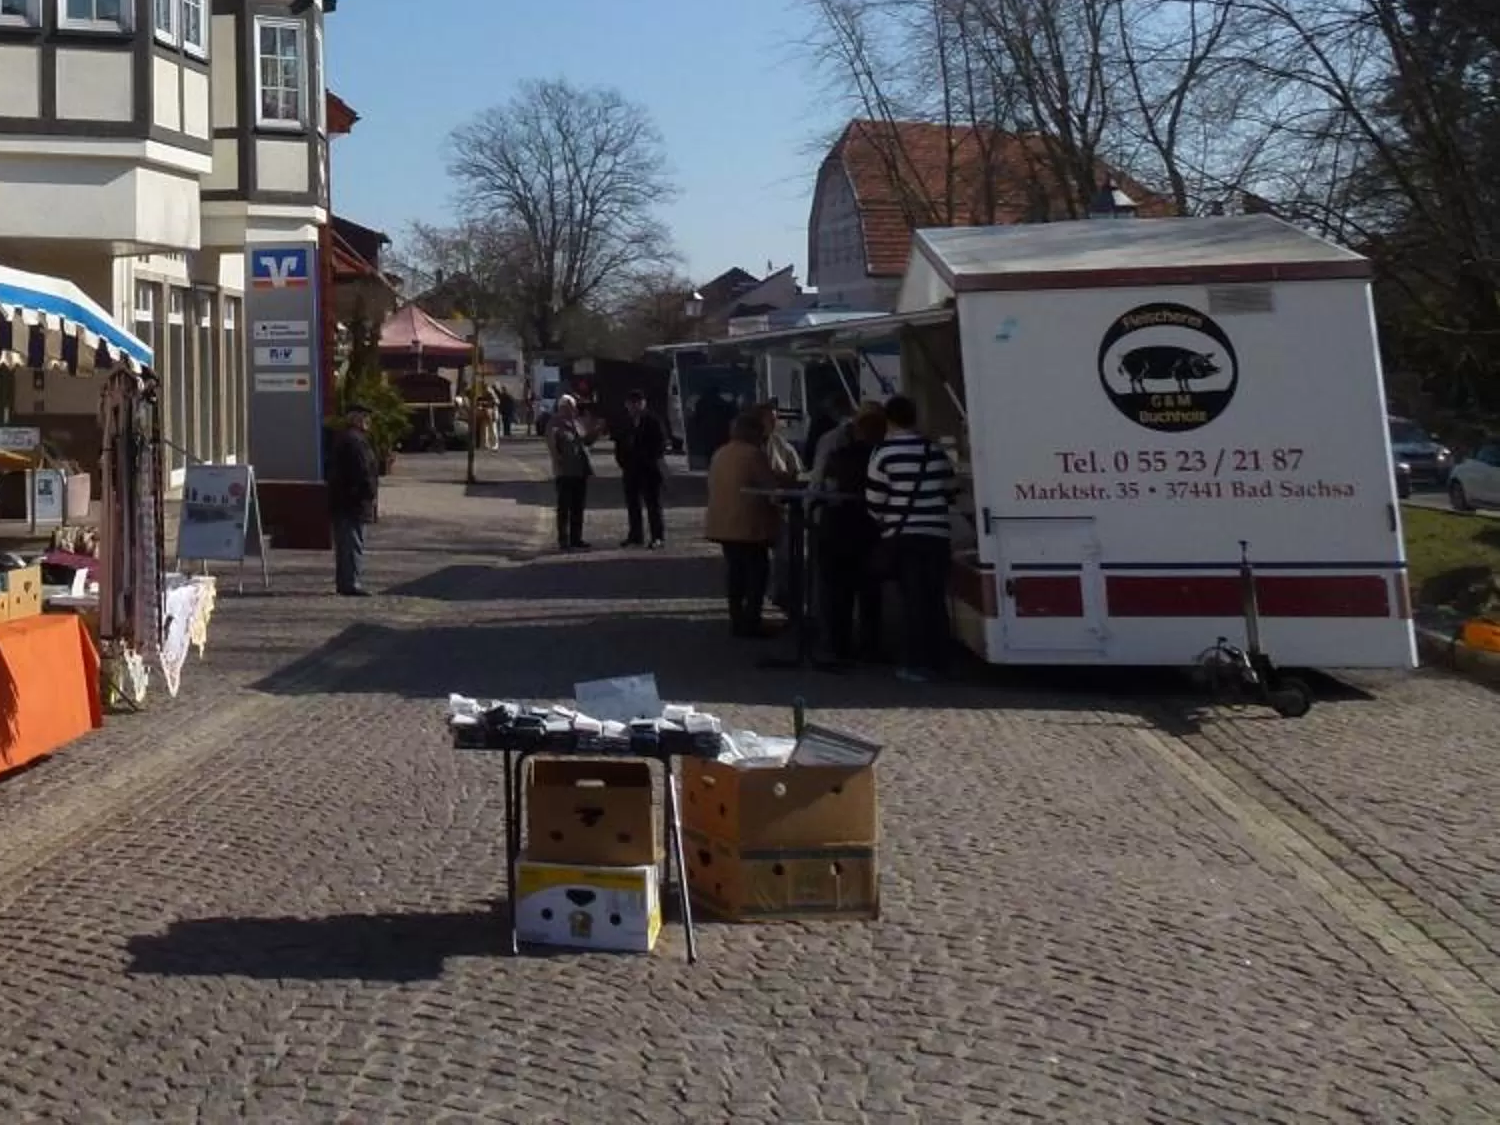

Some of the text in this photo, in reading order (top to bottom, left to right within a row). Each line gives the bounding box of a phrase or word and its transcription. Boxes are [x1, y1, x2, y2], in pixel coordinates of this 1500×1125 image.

[1055, 448, 1304, 476] Tel. 0 55 23 / 21 87
[1014, 479, 1356, 501] Marktstr. 35 37441 Bad Sachsa
